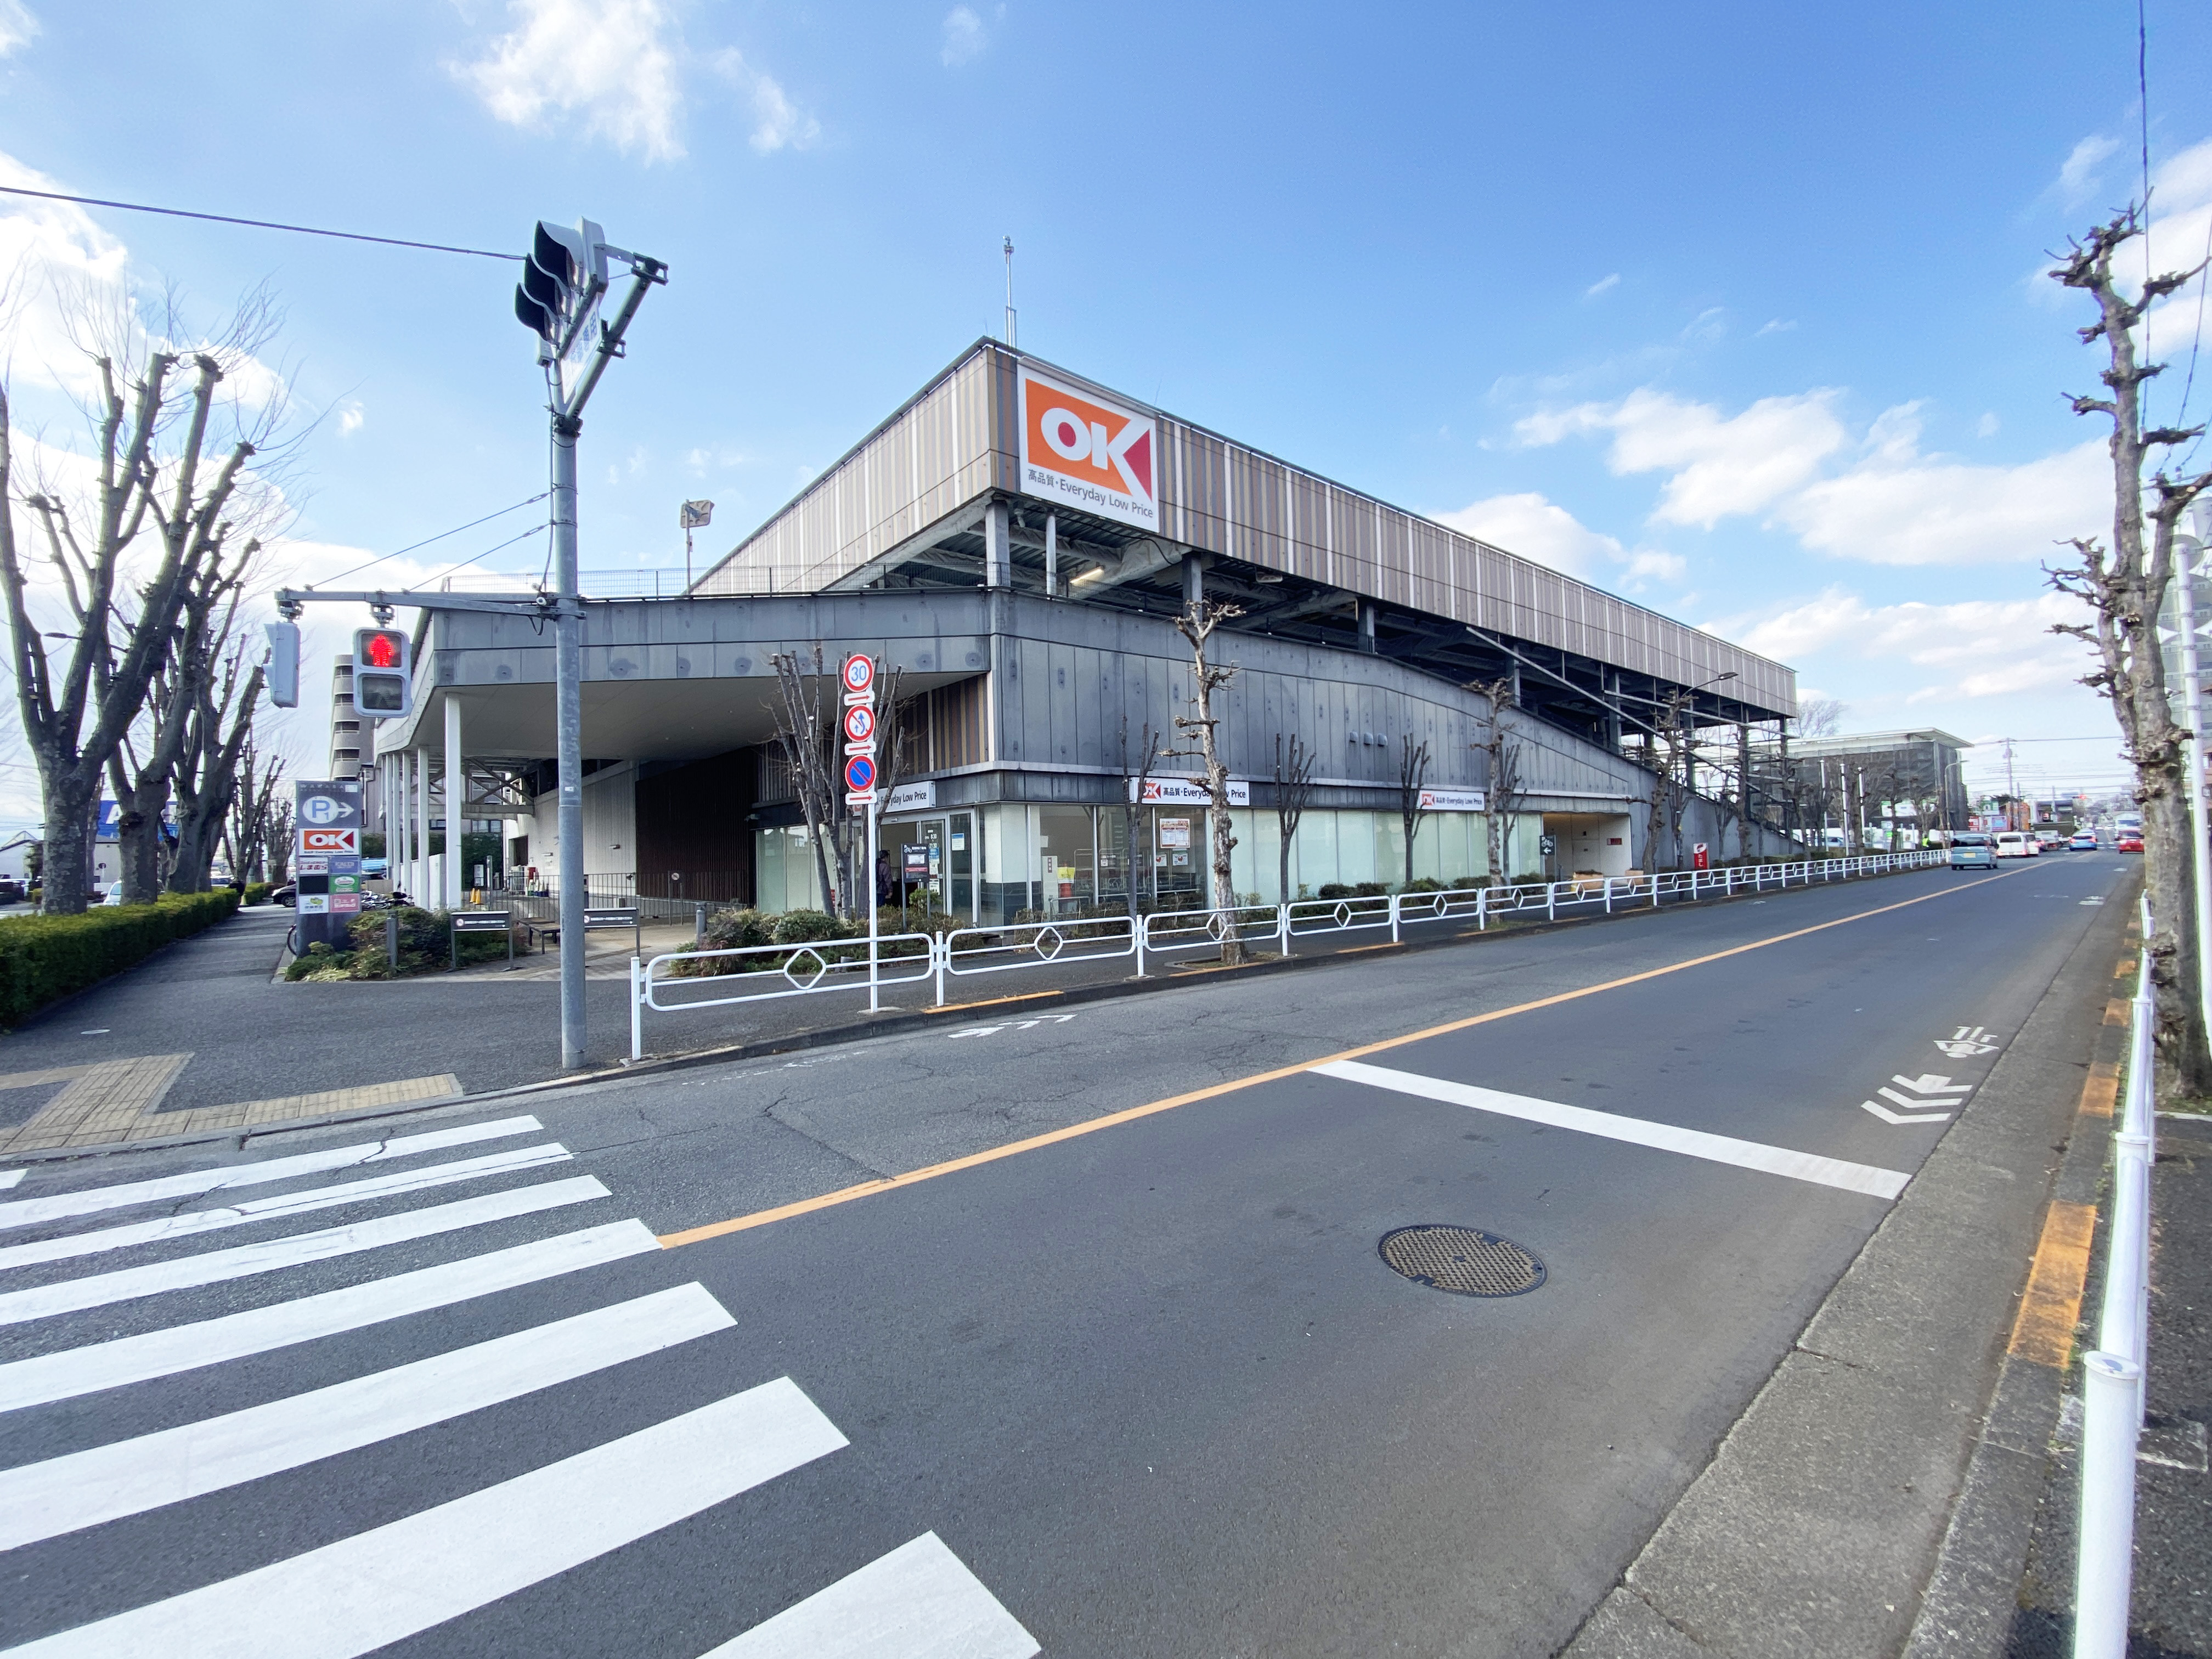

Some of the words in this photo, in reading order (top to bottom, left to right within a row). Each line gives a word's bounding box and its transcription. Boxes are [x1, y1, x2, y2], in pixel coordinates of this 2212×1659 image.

[1041, 408, 1152, 500] OK
[1109, 494, 1128, 510] Low
[1132, 502, 1153, 518] Price
[851, 665, 867, 681] 30
[903, 793, 913, 802] Low
[915, 790, 927, 800] Price
[1183, 788, 1210, 799] Everyda
[1231, 789, 1246, 798] Price
[309, 831, 353, 849] OK
